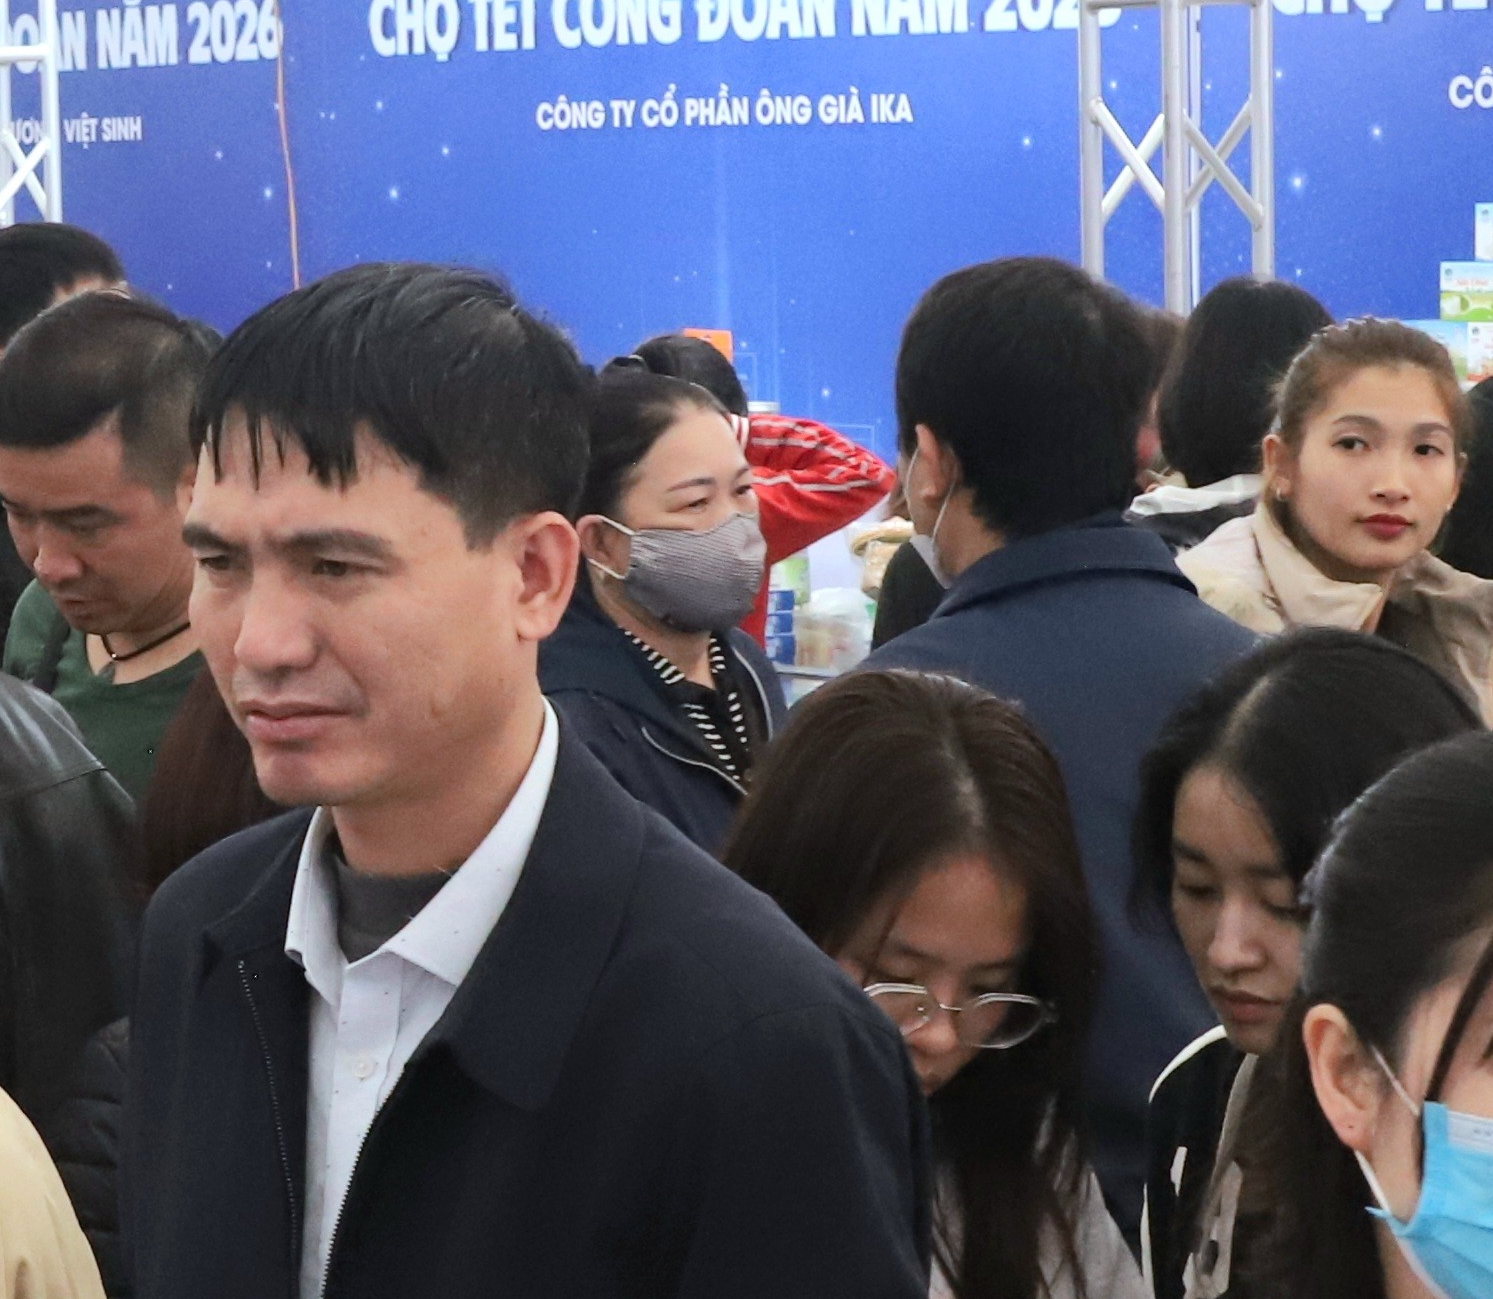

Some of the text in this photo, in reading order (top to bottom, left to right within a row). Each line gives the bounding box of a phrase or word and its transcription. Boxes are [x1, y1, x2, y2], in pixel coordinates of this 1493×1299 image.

[535, 82, 914, 130] CÔNG TY CỔ PHẦN ÔNG GIÀ IKA
[62, 111, 143, 149] VIỆT SINH
